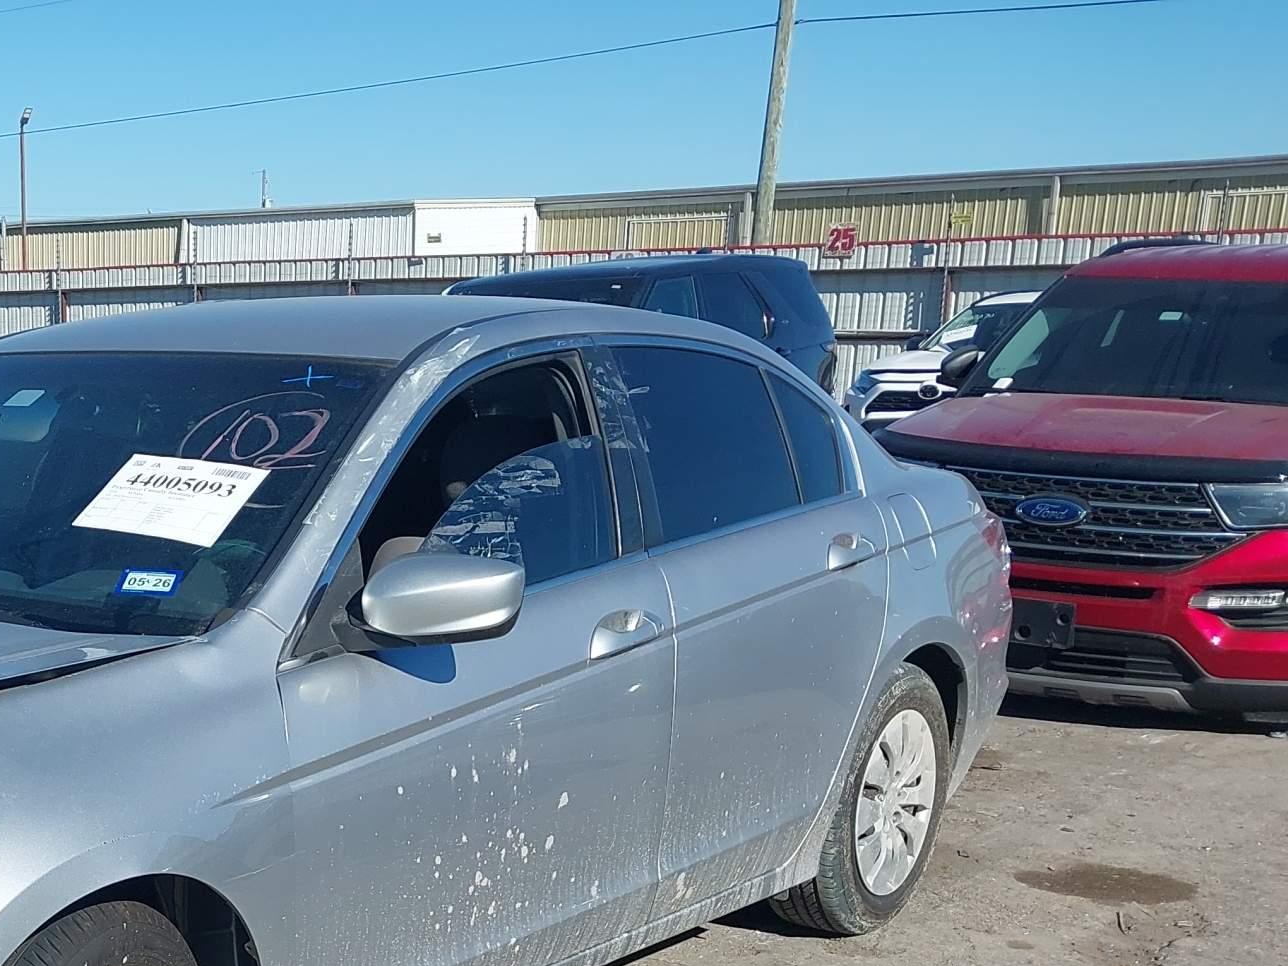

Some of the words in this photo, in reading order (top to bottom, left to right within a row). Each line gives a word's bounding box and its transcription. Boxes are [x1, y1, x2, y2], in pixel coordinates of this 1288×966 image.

[828, 227, 857, 251] 25
[201, 408, 331, 471] 102
[126, 472, 237, 498] 44005093
[1030, 503, 1069, 519] Ford
